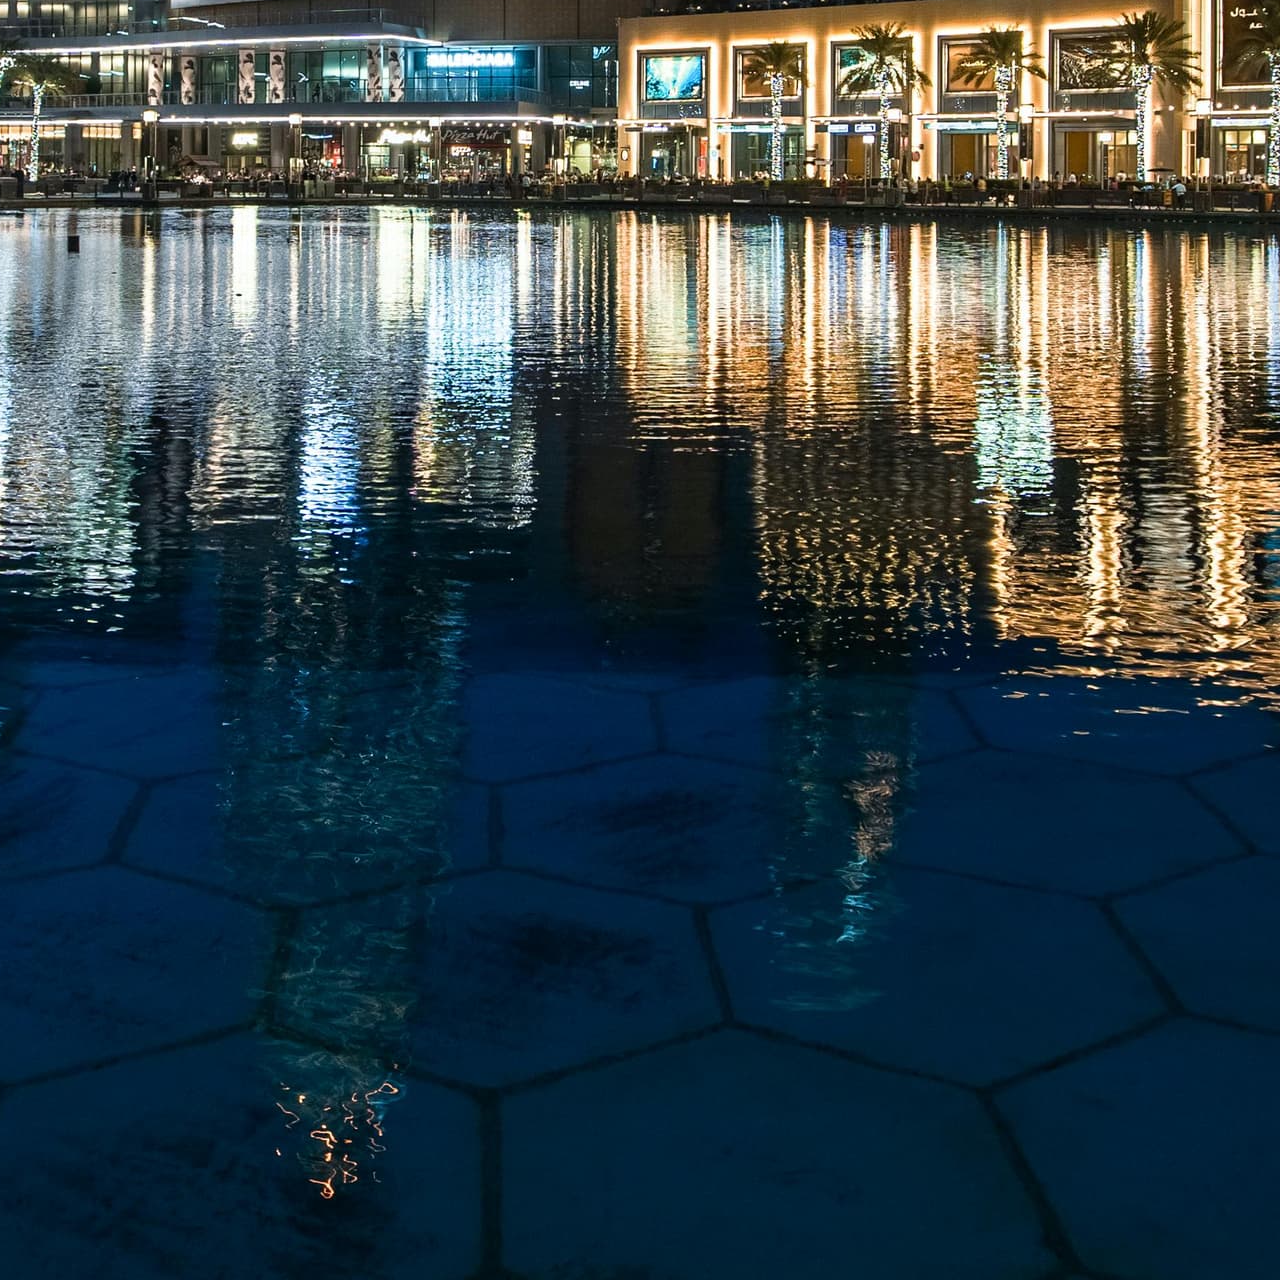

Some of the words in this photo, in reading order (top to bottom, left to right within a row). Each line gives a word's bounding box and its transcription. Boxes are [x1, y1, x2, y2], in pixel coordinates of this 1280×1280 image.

[413, 129, 432, 143] Hu
[441, 129, 475, 143] Pizza
[477, 129, 501, 141] Hut
